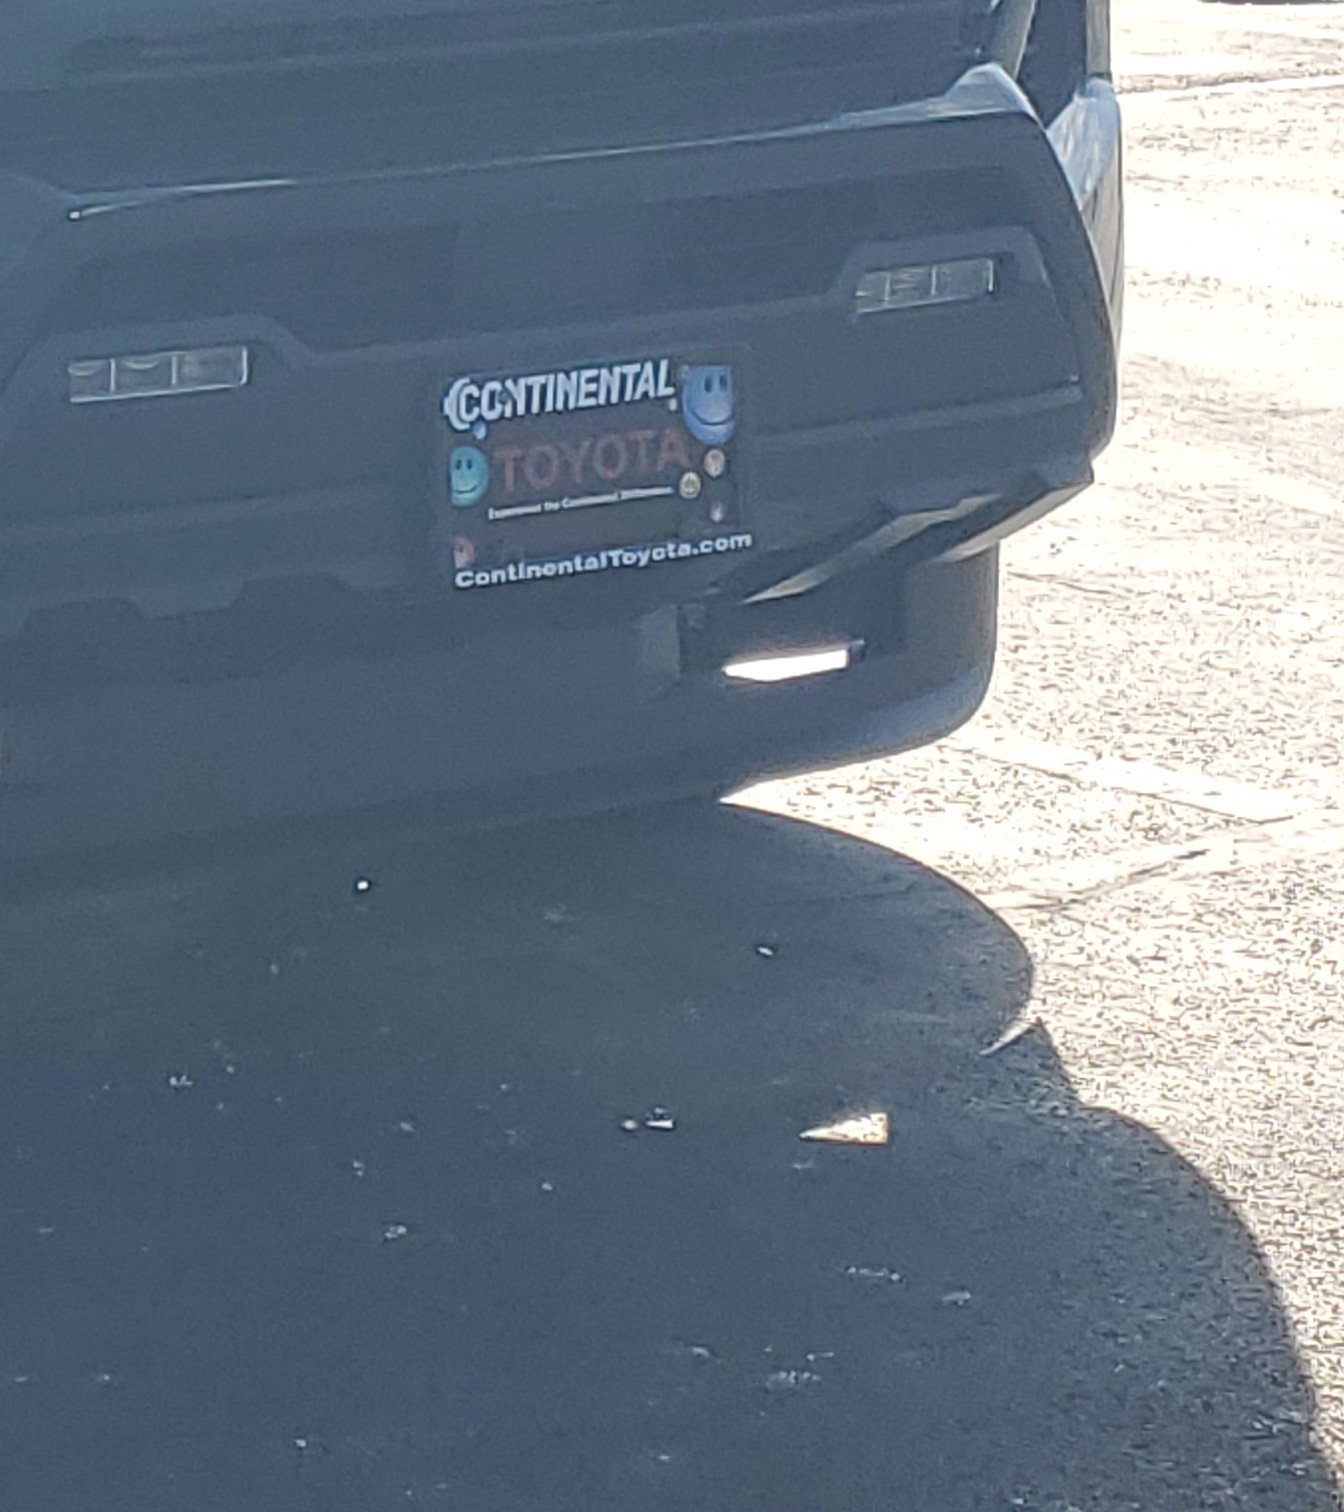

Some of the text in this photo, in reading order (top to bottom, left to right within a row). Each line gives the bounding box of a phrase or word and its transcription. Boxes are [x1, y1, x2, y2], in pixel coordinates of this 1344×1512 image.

[450, 359, 674, 426] CONTINENTAL
[496, 430, 689, 492] TOYOTA
[455, 534, 752, 589] ContinentalToyota.com
